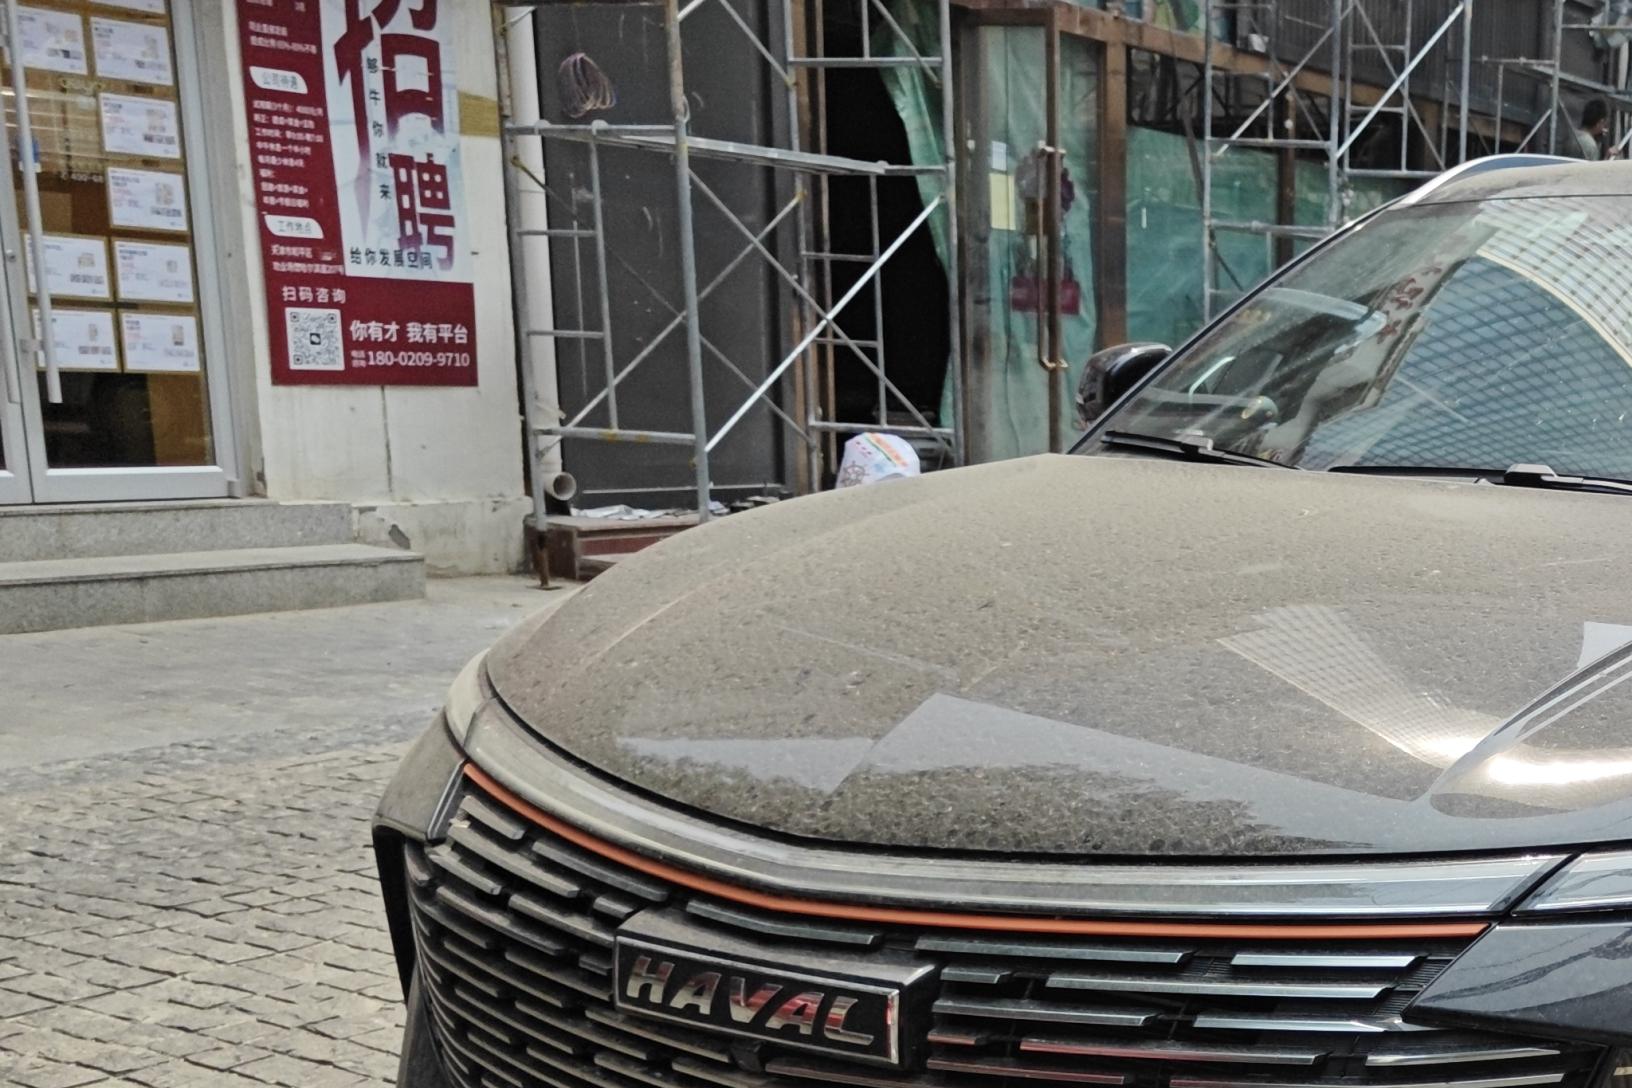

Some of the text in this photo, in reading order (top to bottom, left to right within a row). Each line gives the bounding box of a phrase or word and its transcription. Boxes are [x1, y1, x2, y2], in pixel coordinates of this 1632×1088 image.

[333, 0, 456, 272] 招聘
[366, 57, 393, 200] 够牛你就来
[350, 247, 433, 270] 给你发展空间
[282, 285, 346, 305] 扫码咨询
[350, 319, 468, 344] 你有才 我有平台
[368, 350, 470, 368] 180-0209-9710
[626, 955, 875, 1047] HAVAL
